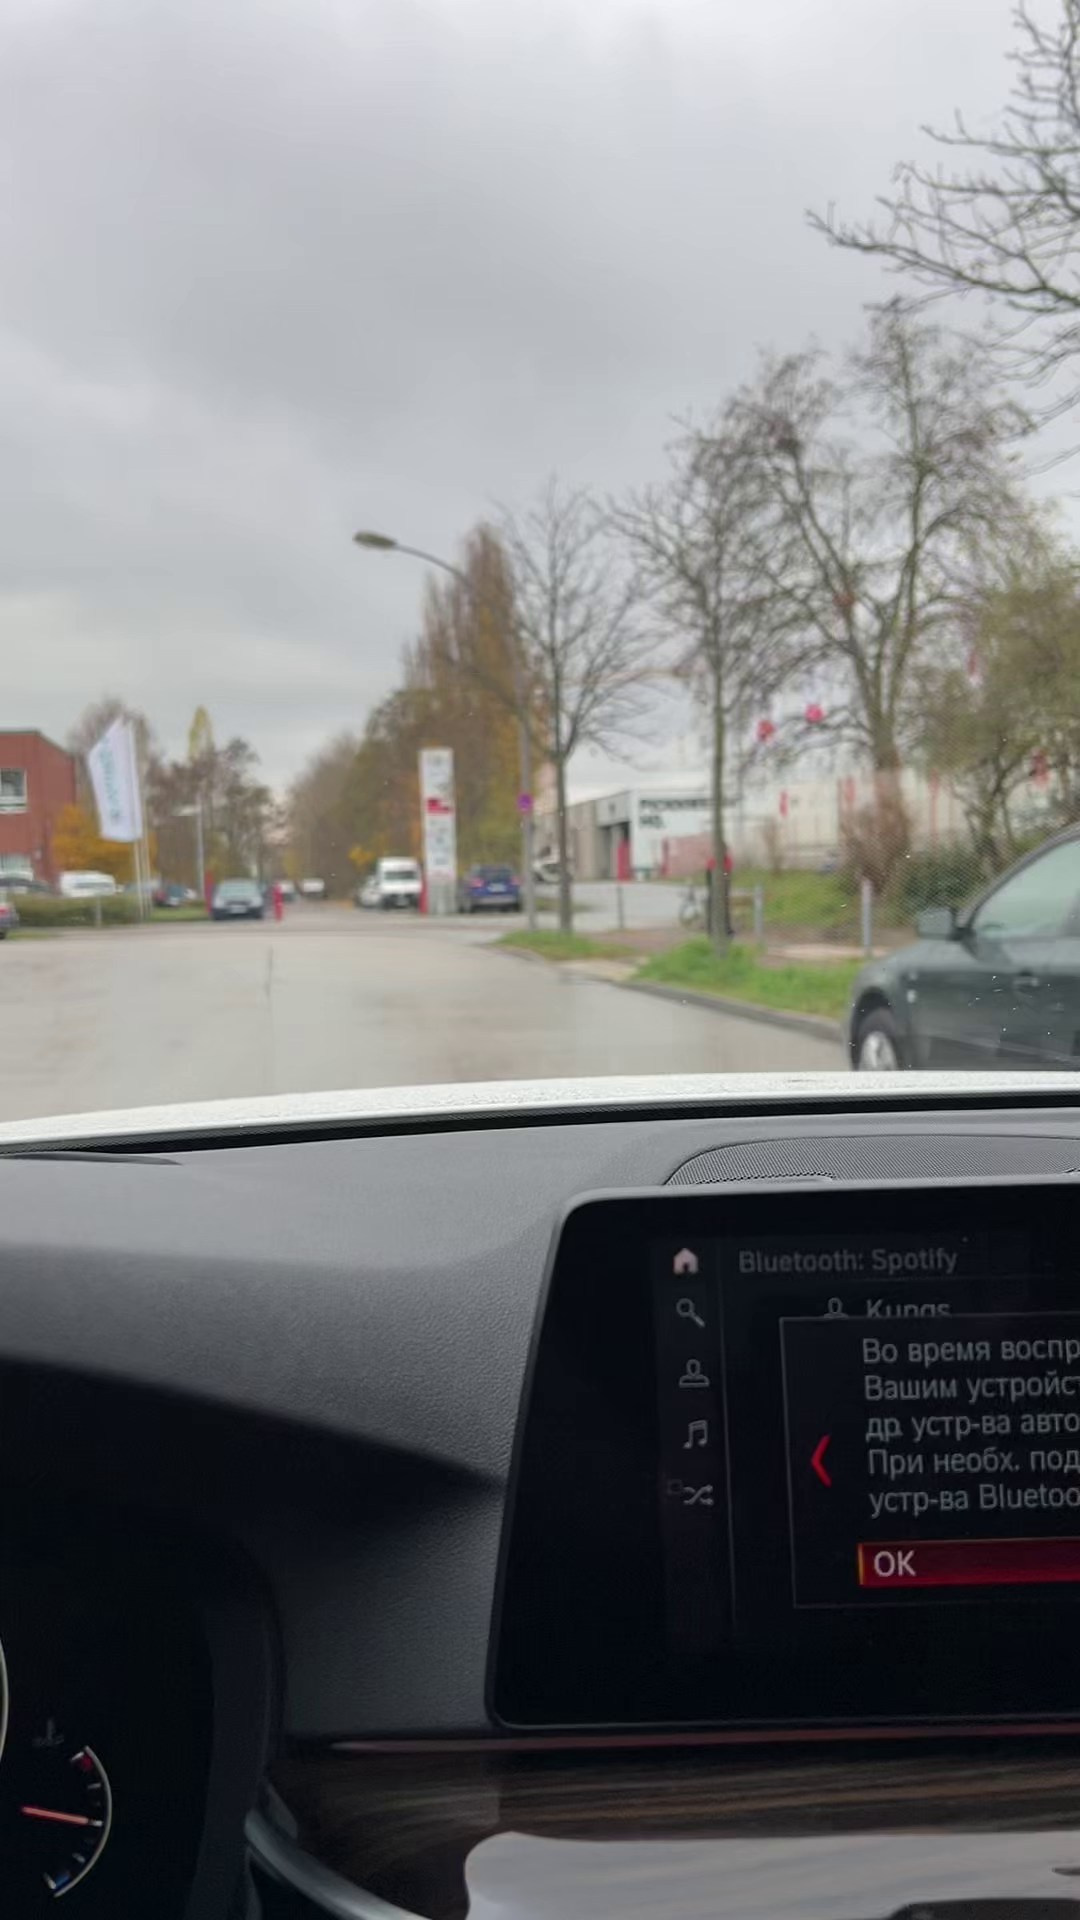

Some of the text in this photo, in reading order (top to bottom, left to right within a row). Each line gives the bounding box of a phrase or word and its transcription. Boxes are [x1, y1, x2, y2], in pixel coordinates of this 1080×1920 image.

[738, 1247, 959, 1274] Bluetooth: Spotify
[862, 1338, 1080, 1368] Во время воспр
[864, 1375, 958, 1399] Вашим
[911, 1414, 1011, 1442] устр-ва
[1020, 1412, 1080, 1434] авто
[867, 1449, 924, 1481] При
[934, 1446, 1020, 1474] необх.
[869, 1483, 1080, 1519] устр-ва Bluetoo
[873, 1550, 917, 1578] OK
